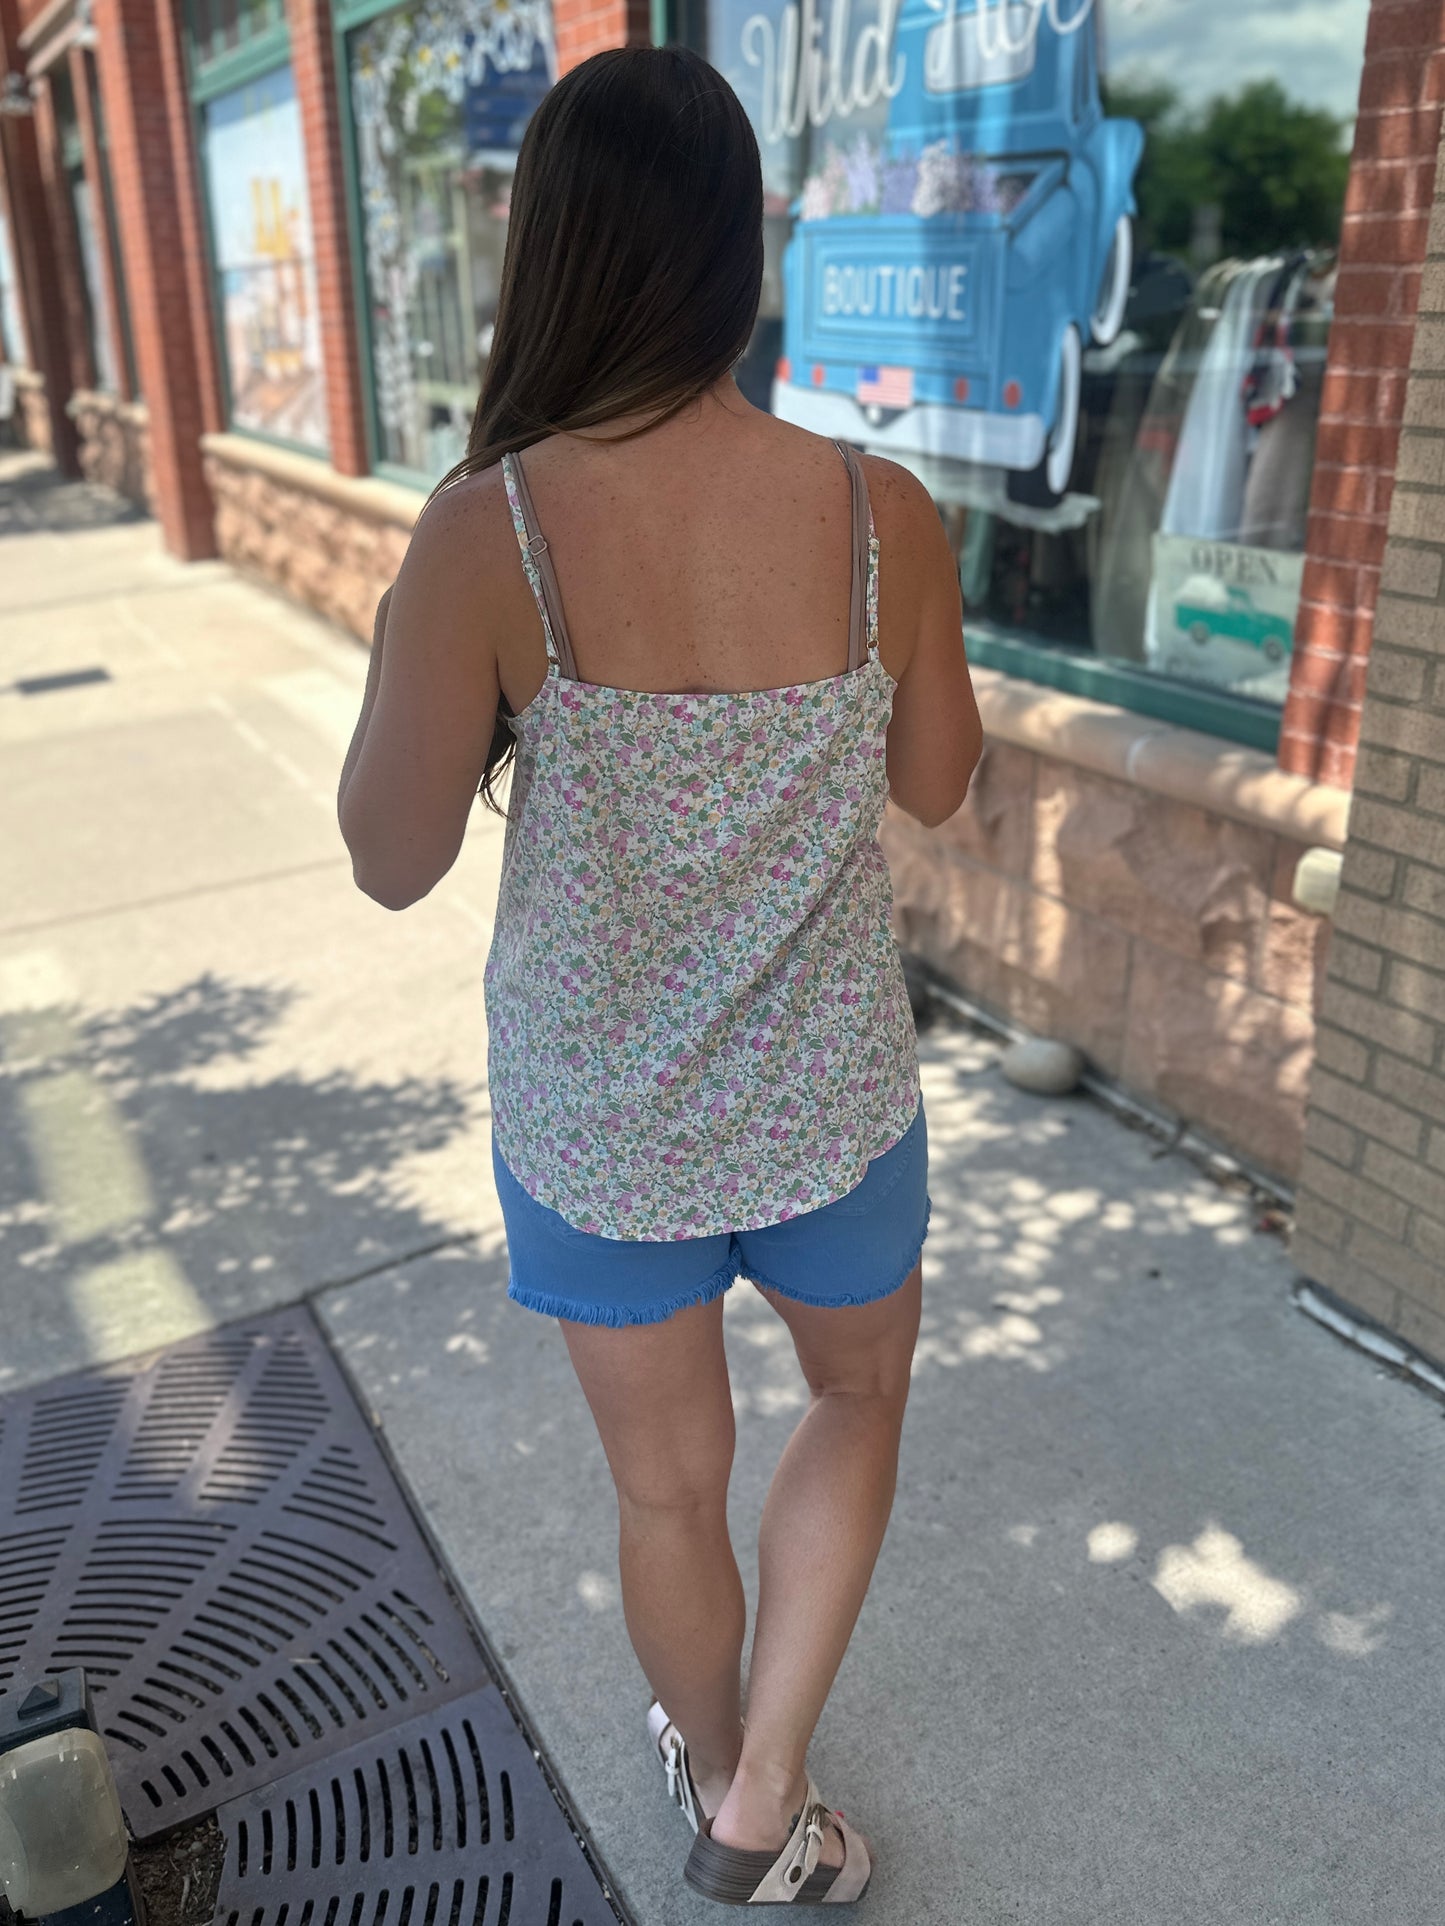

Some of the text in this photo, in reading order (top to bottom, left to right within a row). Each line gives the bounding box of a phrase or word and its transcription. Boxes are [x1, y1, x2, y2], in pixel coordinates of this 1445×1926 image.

[741, 0, 906, 144] Wild
[823, 264, 968, 321] BOUTIQUE
[1190, 546, 1282, 586] OPEN
